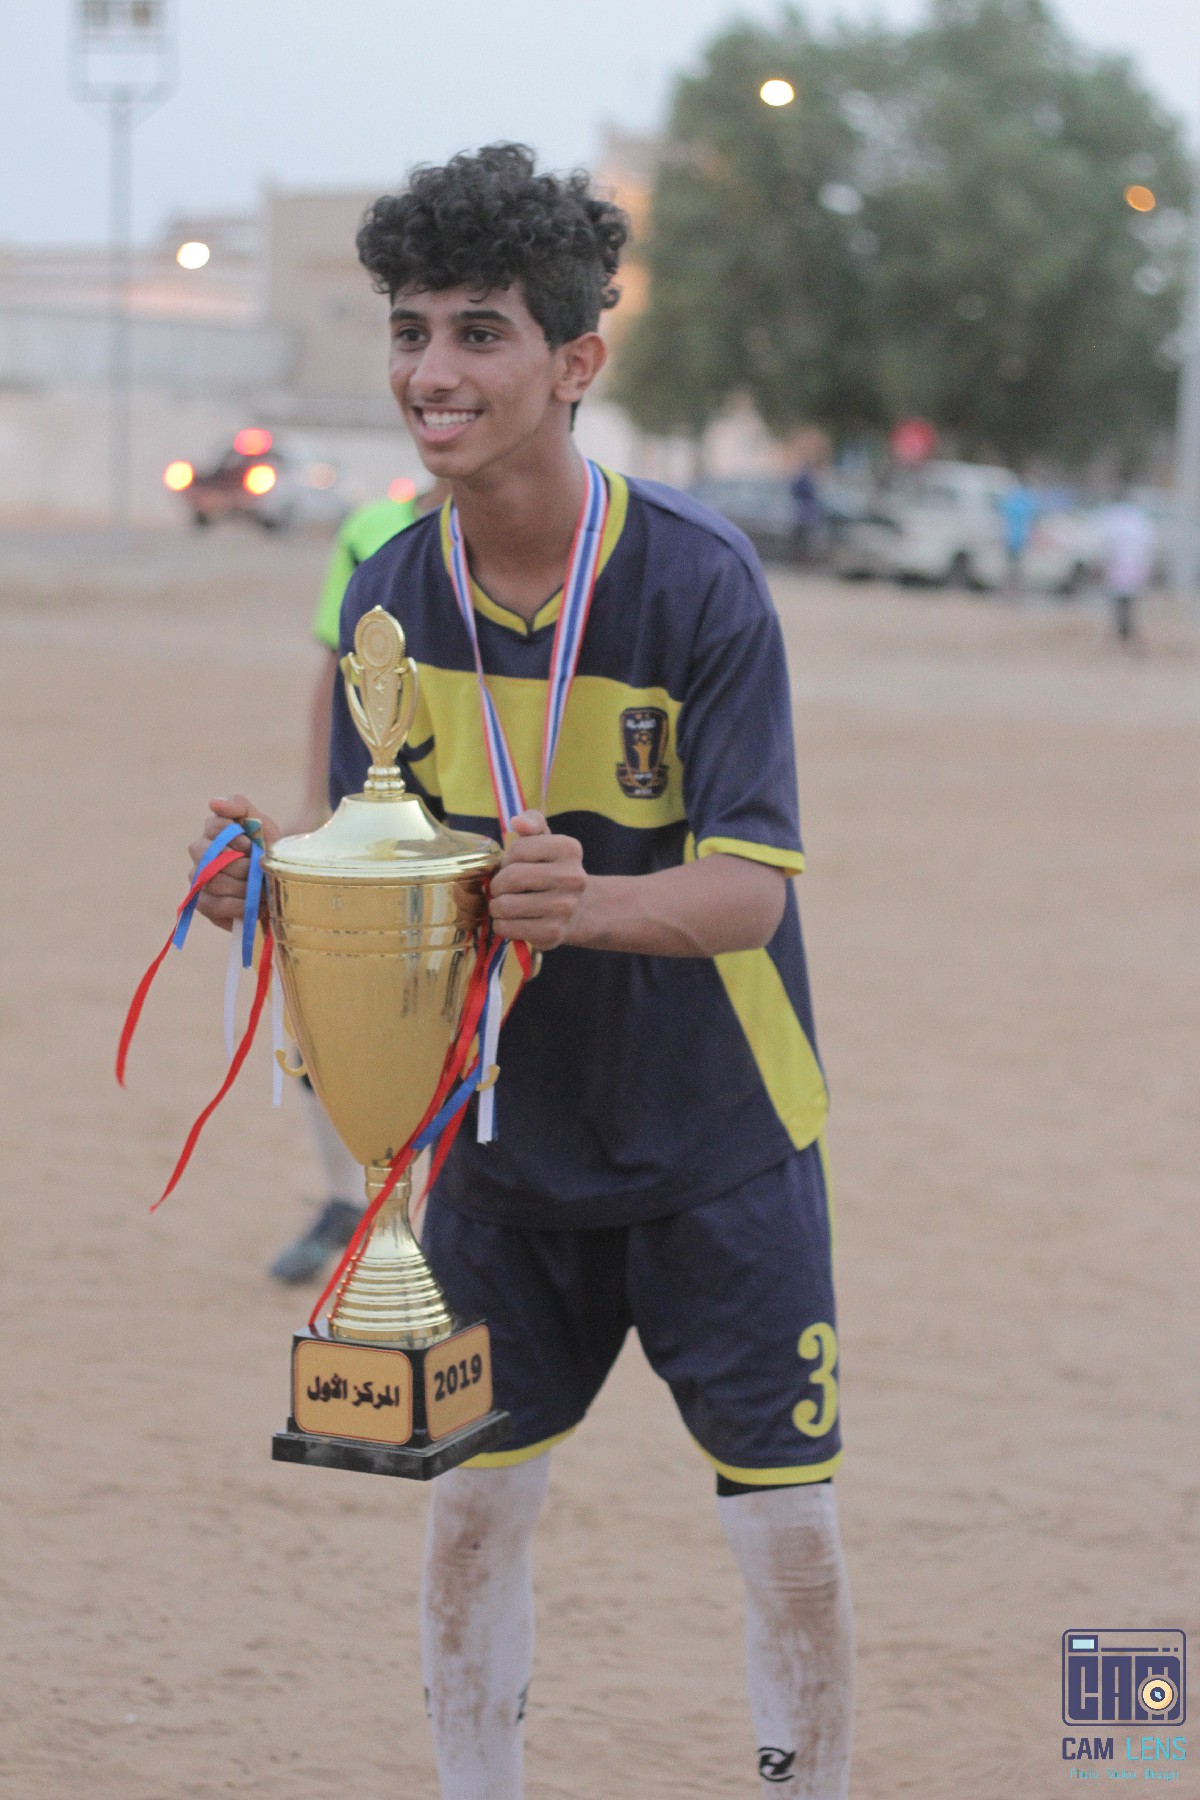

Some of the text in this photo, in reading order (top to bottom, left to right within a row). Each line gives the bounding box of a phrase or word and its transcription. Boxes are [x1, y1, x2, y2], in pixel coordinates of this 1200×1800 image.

[352, 1381, 399, 1410] المركز
[434, 1354, 482, 1401] 2019
[792, 1322, 837, 1437] 3
